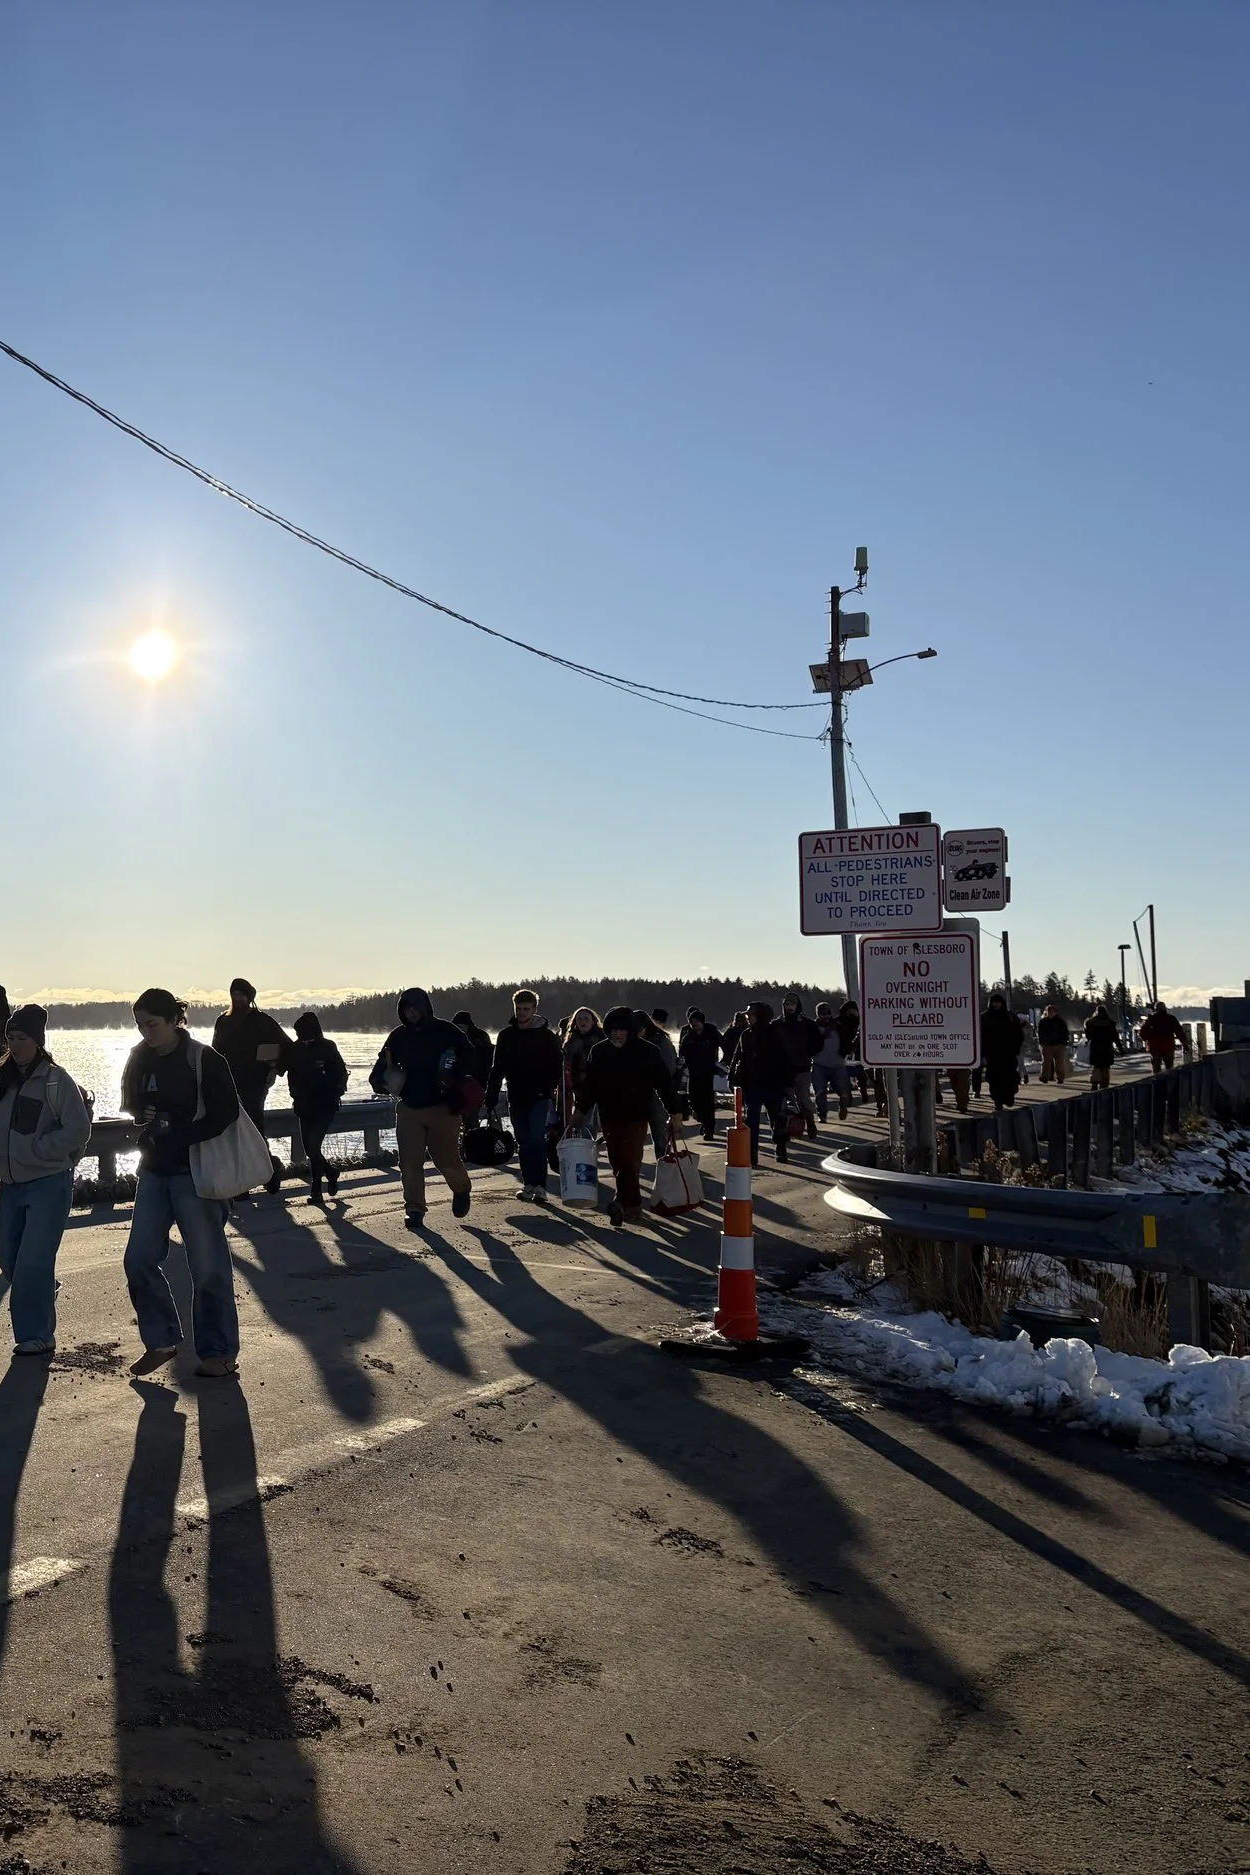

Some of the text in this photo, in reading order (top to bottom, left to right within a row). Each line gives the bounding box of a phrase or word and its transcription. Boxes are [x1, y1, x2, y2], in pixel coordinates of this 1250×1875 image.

[812, 831, 919, 854] ATTENTION
[807, 855, 933, 874] ALL PEDESTRIANS
[830, 872, 908, 888] STOP HERE
[815, 887, 925, 904] UNTIL DIRECTED
[949, 888, 1001, 901] Clean Air Zone
[827, 904, 914, 919] TO PROCEED
[849, 920, 871, 928] Thank
[869, 946, 894, 956] TOWN
[897, 945, 909, 955] OF
[903, 960, 930, 978] NO
[885, 981, 949, 994] OVERNIGHT
[867, 996, 969, 1009] PARKING WITHOUT
[892, 1013, 944, 1025] PLACARD
